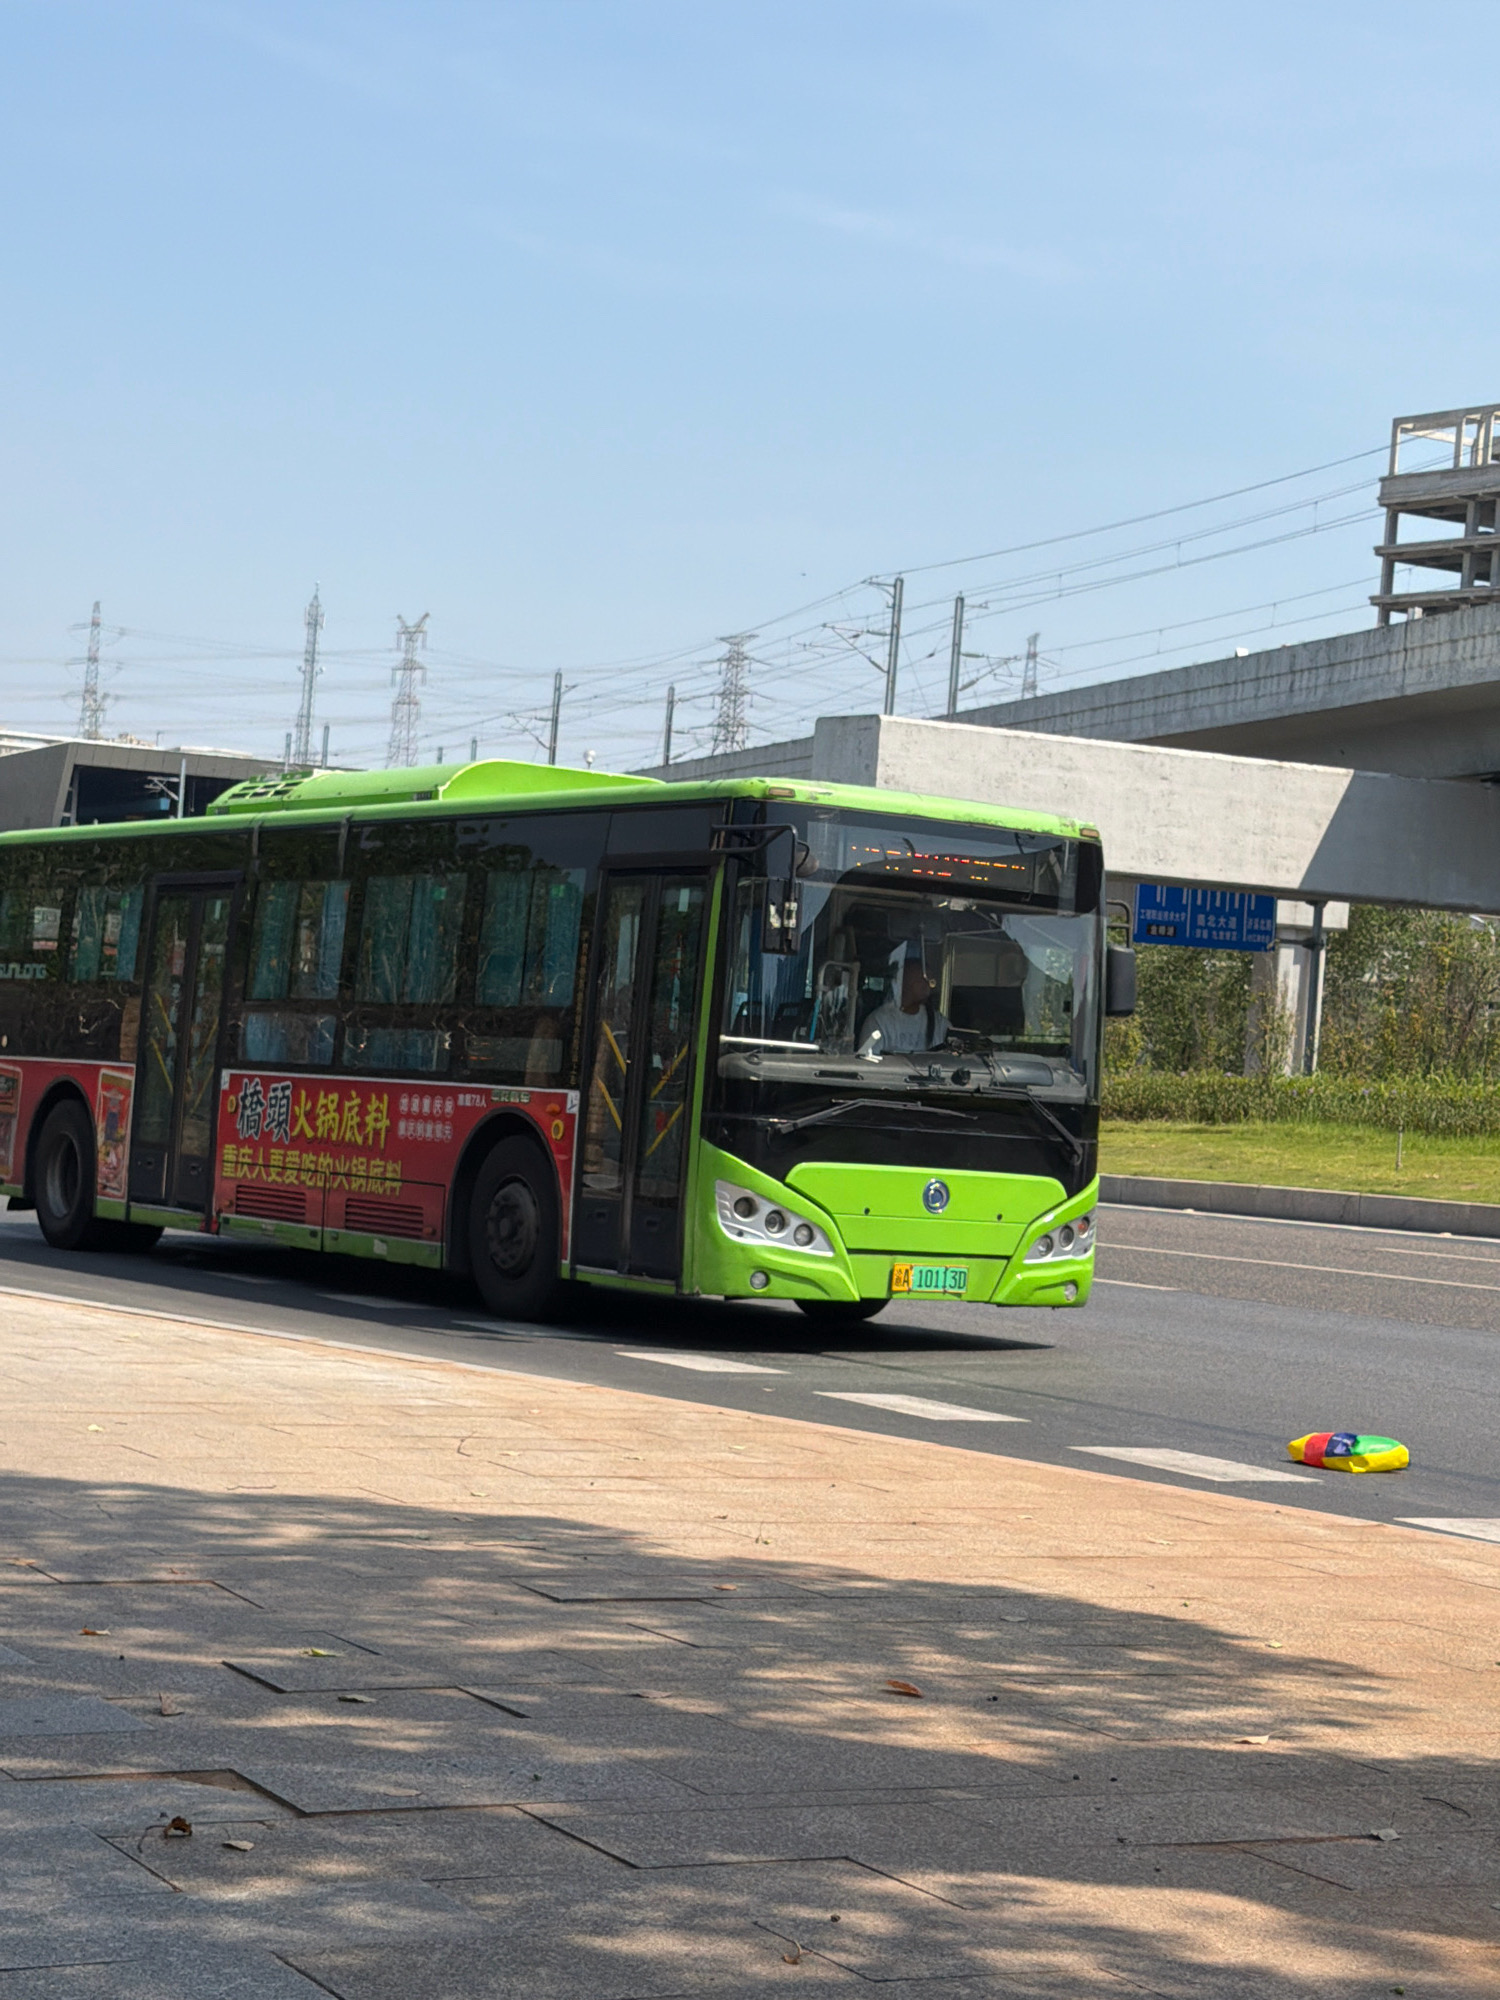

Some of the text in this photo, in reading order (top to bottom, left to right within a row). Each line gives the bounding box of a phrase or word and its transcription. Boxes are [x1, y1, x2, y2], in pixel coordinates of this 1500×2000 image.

[291, 1089, 390, 1150] 火锅底料
[221, 1143, 403, 1196] 重庆人更爱吃的火锅底料
